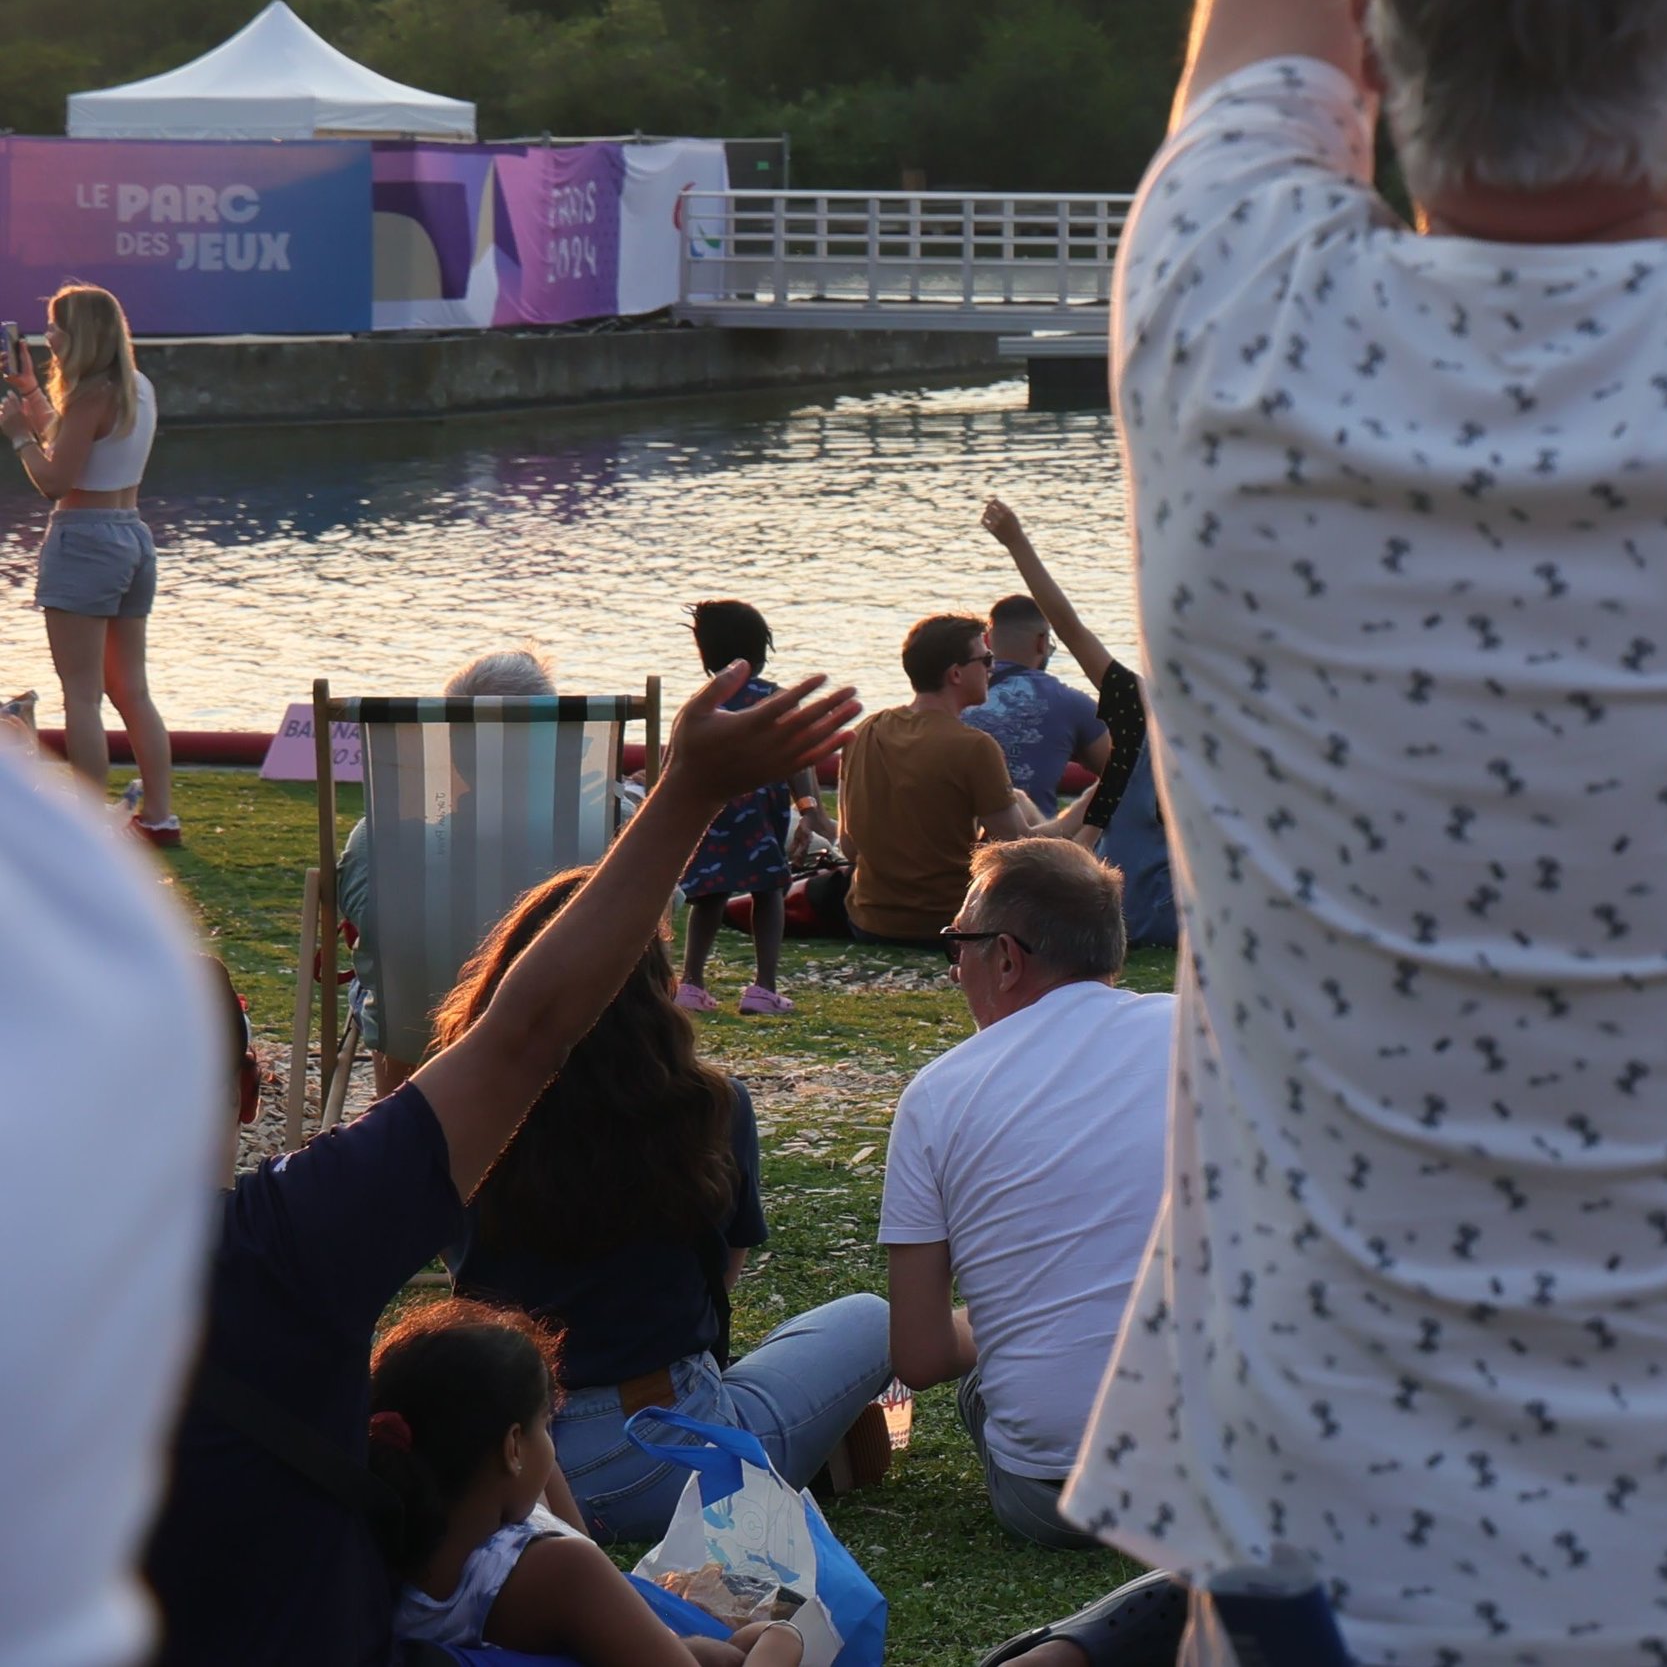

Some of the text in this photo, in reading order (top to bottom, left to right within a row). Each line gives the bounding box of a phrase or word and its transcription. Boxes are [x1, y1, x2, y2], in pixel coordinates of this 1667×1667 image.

[76, 183, 261, 224] LE PARC
[116, 232, 291, 272] DES JEUX
[546, 235, 597, 284] 2024
